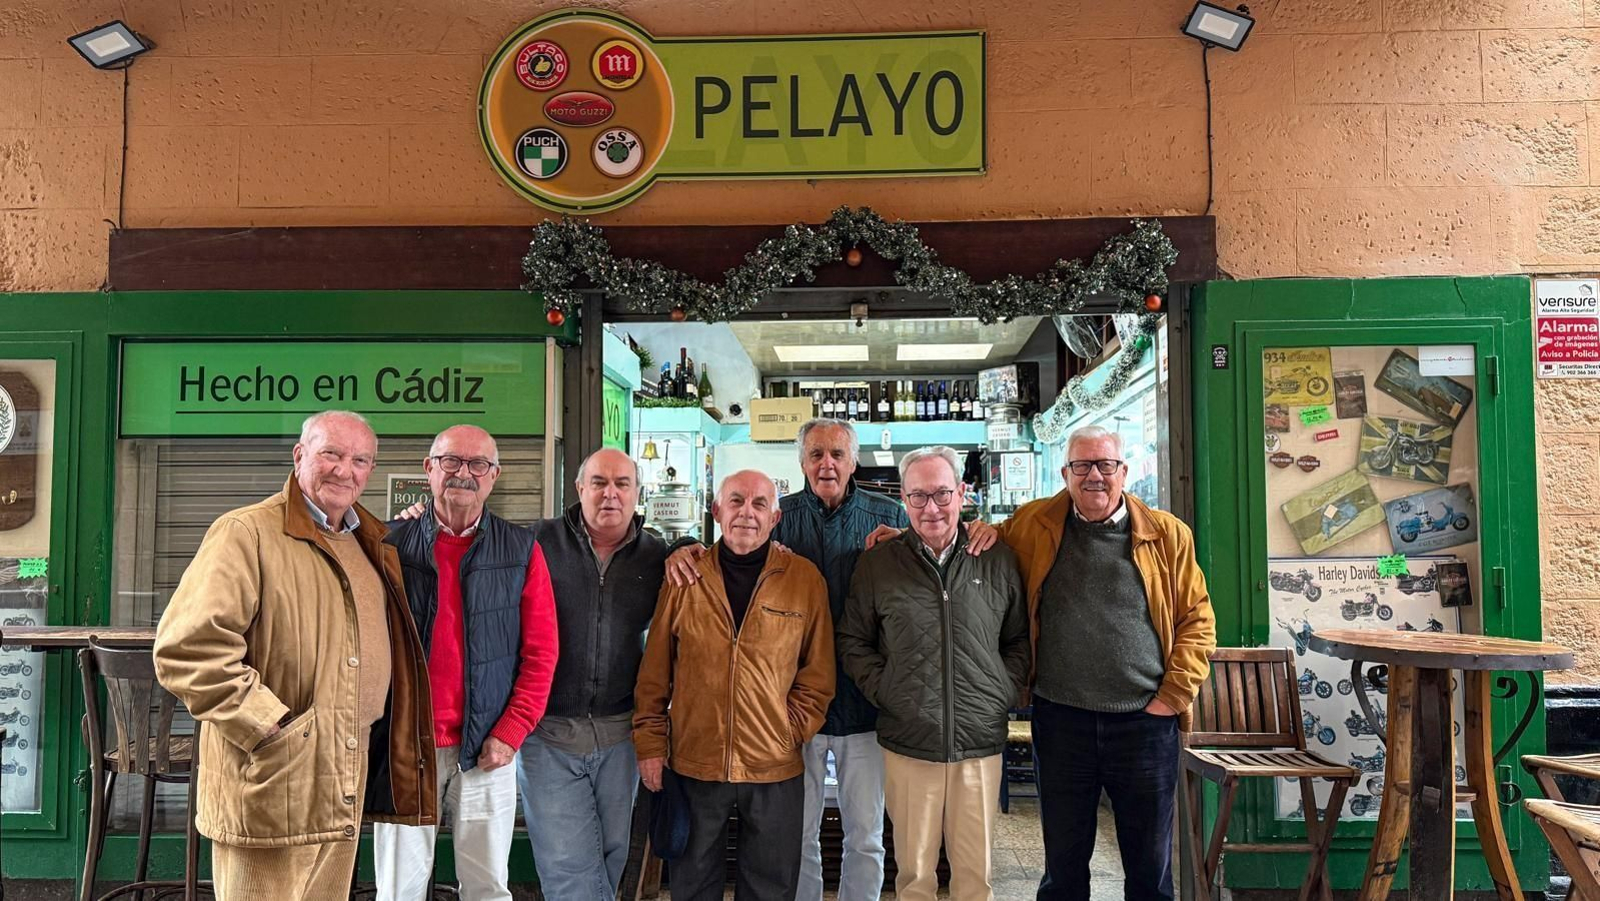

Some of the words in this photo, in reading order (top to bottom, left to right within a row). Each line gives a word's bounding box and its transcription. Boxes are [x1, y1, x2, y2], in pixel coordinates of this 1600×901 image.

[519, 44, 565, 75] BULTACO
[694, 70, 964, 139] PELAYO
[550, 108, 576, 116] MOTO
[579, 108, 608, 116] GUZZI
[523, 136, 559, 147] PUCH
[597, 131, 637, 152] OSSA
[1538, 297, 1597, 307] verisure
[1540, 320, 1598, 333] Alarma
[1564, 340, 1598, 348] imágenes
[1566, 334, 1598, 342] grabación
[1541, 350, 1564, 358] Aviso
[1572, 349, 1599, 358] Policía
[179, 365, 299, 402] Hecho
[313, 373, 358, 402] en
[374, 365, 486, 404] Cádiz
[394, 492, 430, 505] BOLO
[653, 509, 679, 517] CASERO
[1318, 565, 1348, 584] Harley
[1350, 565, 1392, 580] Davids
